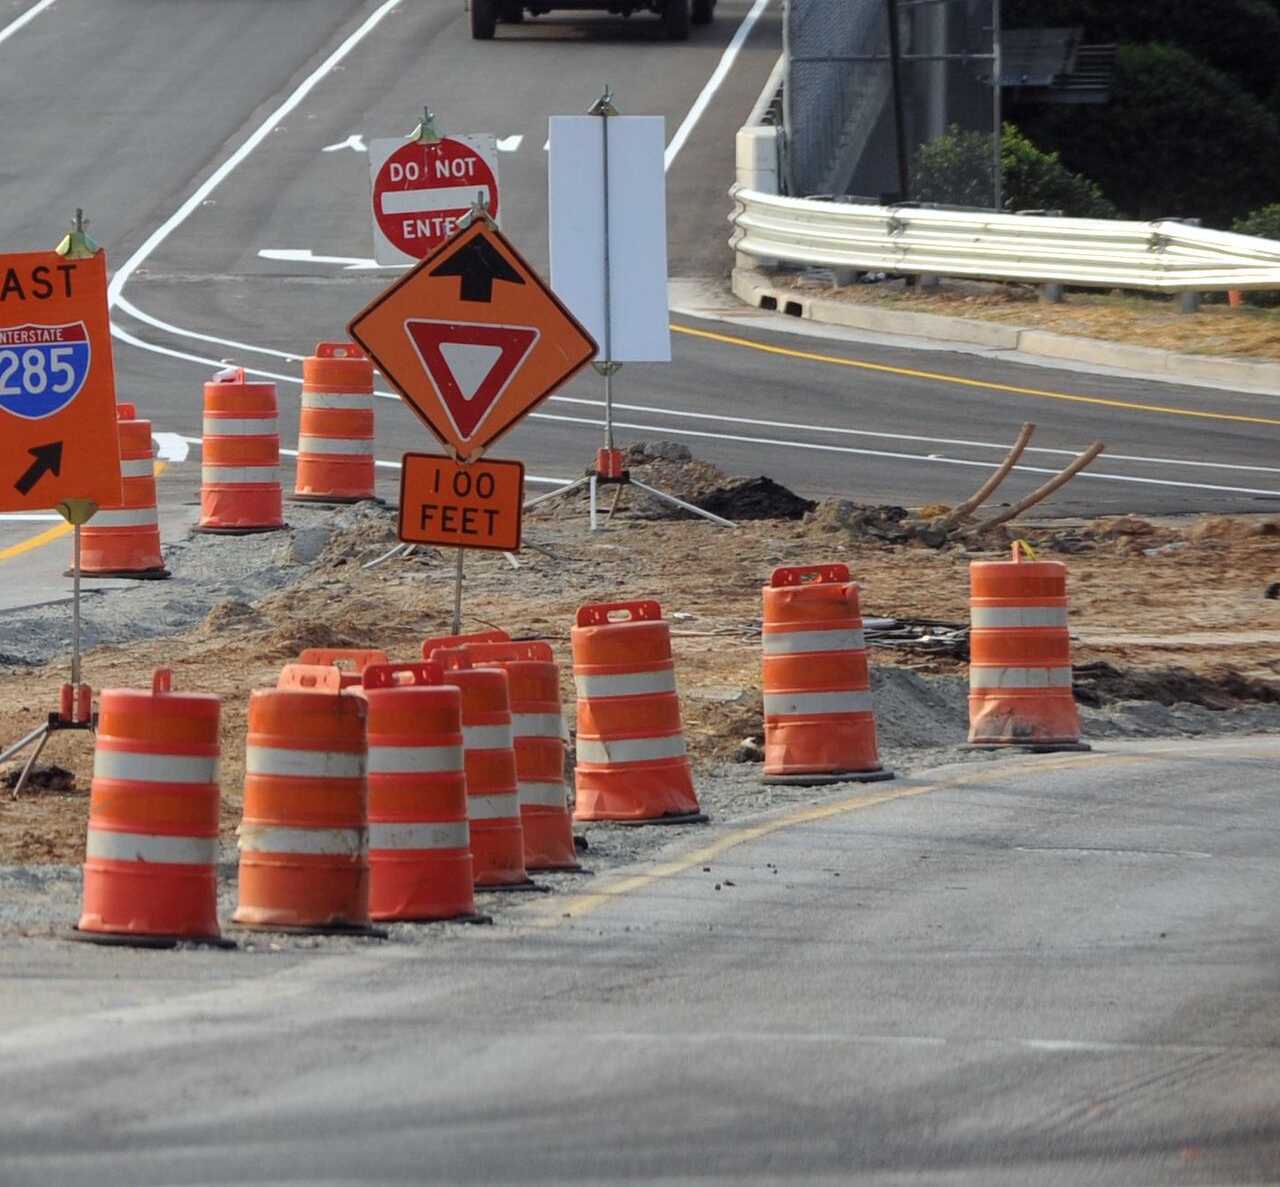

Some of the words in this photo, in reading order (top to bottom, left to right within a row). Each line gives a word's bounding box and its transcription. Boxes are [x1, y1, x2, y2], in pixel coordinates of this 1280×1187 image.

[389, 161, 420, 183] DO
[435, 157, 477, 179] NOT
[402, 216, 458, 239] ENTE
[434, 469, 496, 499] 100
[420, 504, 500, 536] FEET
